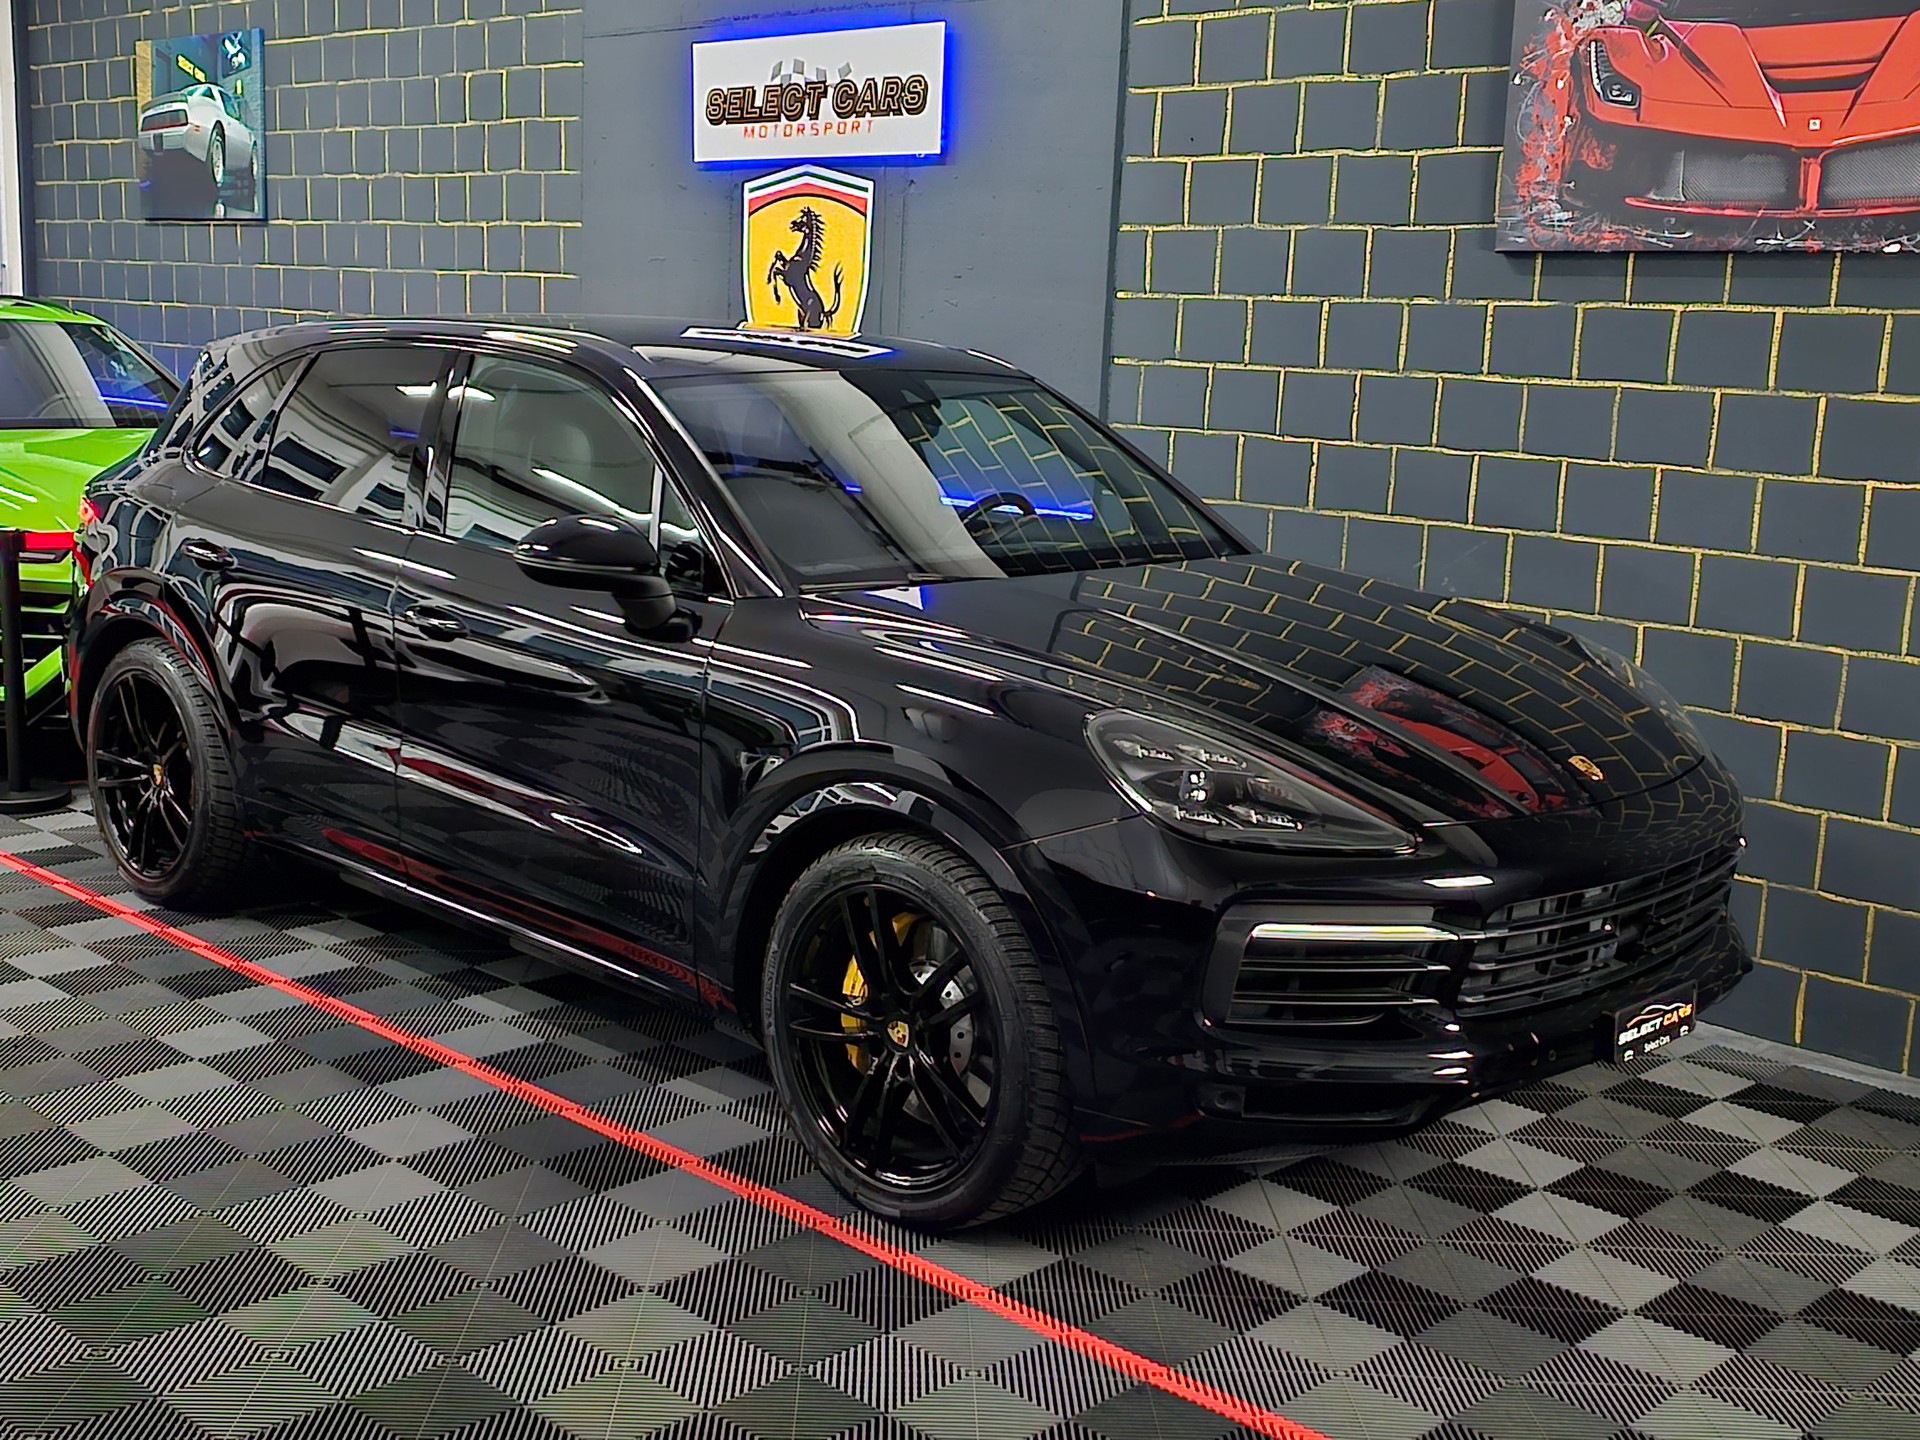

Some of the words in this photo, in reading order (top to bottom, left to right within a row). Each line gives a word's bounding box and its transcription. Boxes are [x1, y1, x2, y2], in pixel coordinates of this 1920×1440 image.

[705, 80, 827, 126] SELECT
[832, 74, 928, 119] CARS
[743, 120, 874, 139] MOTORSPORT
[1618, 1017, 1663, 1045] SELECT
[1663, 1004, 1692, 1026] CARS
